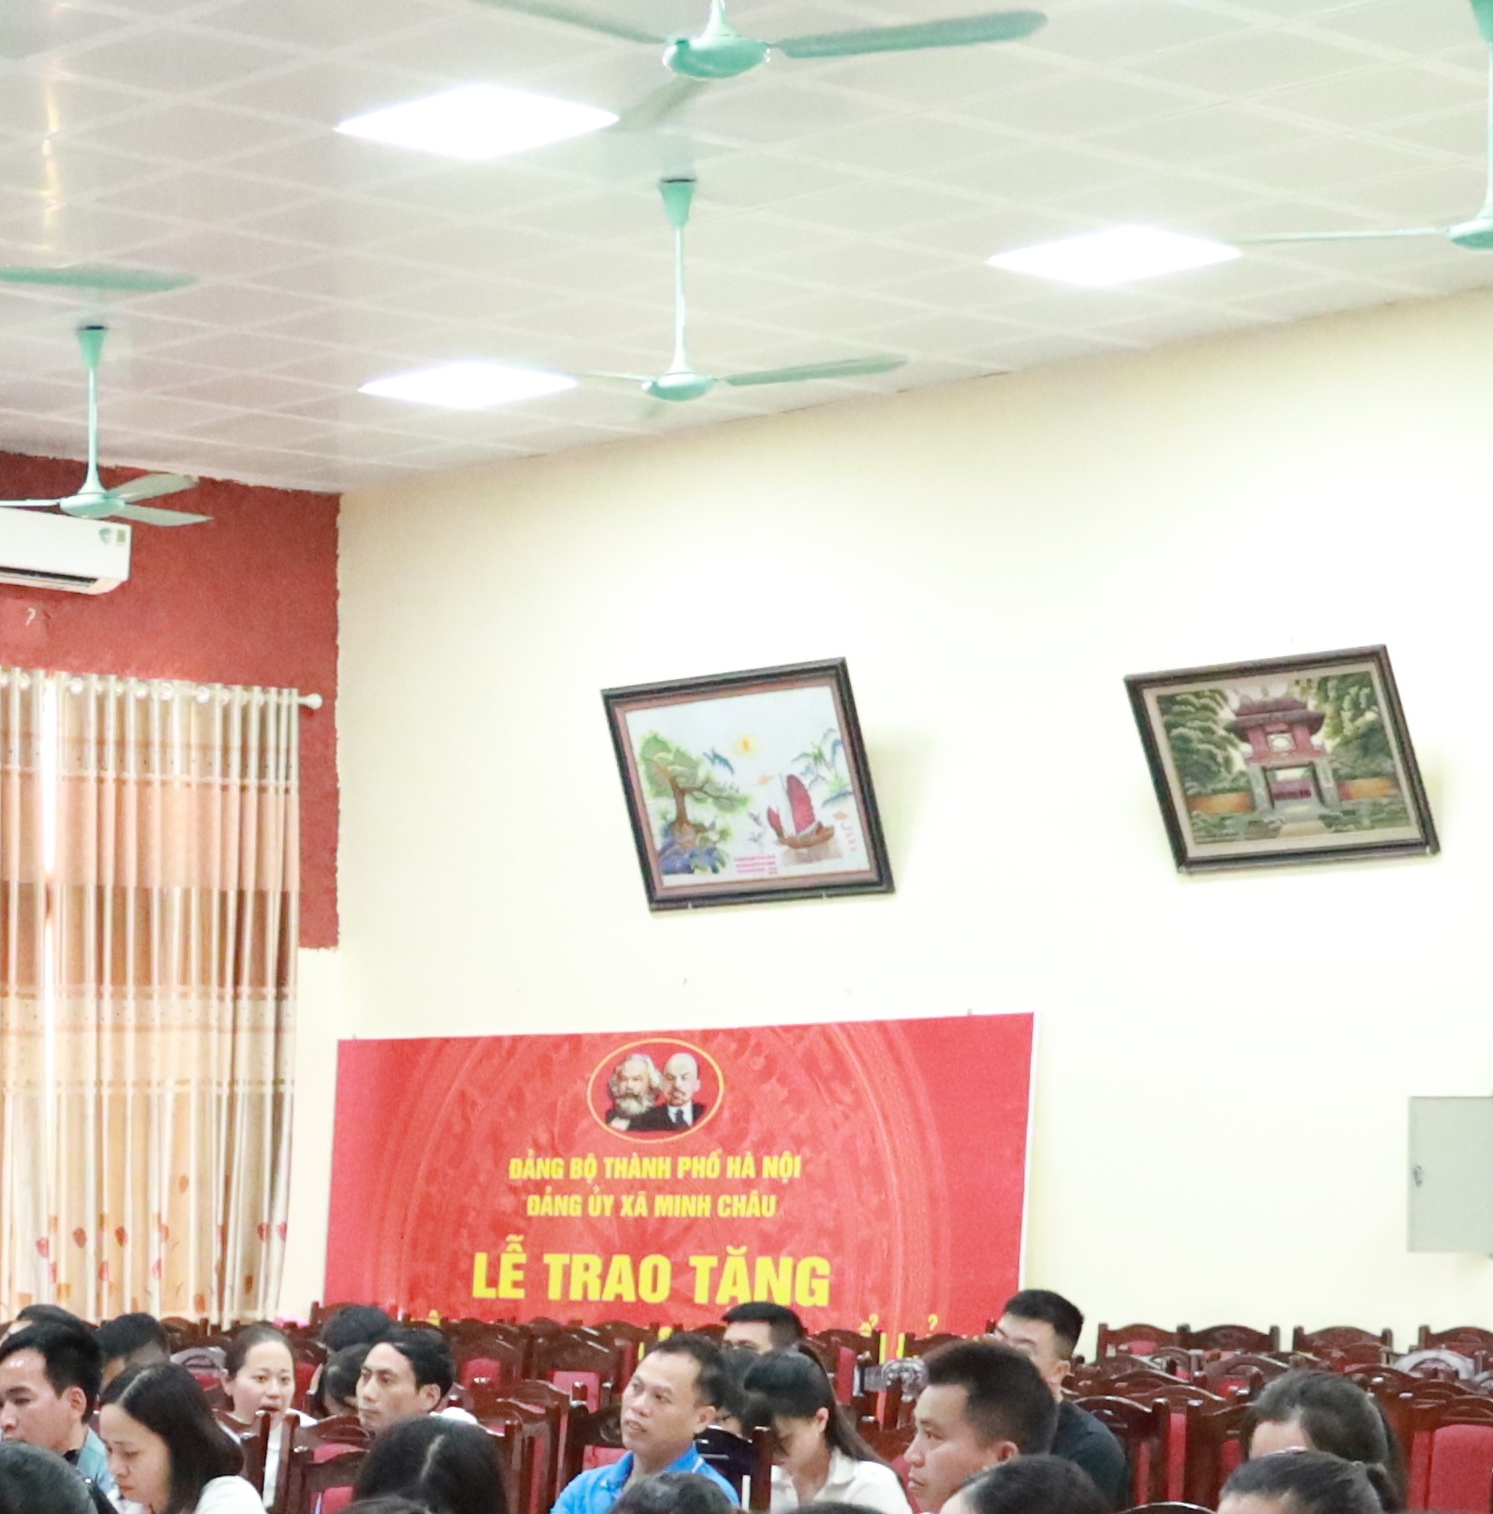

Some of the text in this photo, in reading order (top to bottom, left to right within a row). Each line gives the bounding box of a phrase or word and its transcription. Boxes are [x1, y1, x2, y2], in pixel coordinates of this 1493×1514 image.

[508, 1148, 803, 1184] ĐẢNG BỘ THÀNH PHỐ HÀ NỘI
[526, 1184, 778, 1218] ĐẢNG ỦY XÃ MINH CHÂU
[472, 1234, 528, 1300] LỄ
[543, 1253, 673, 1304] TRAO
